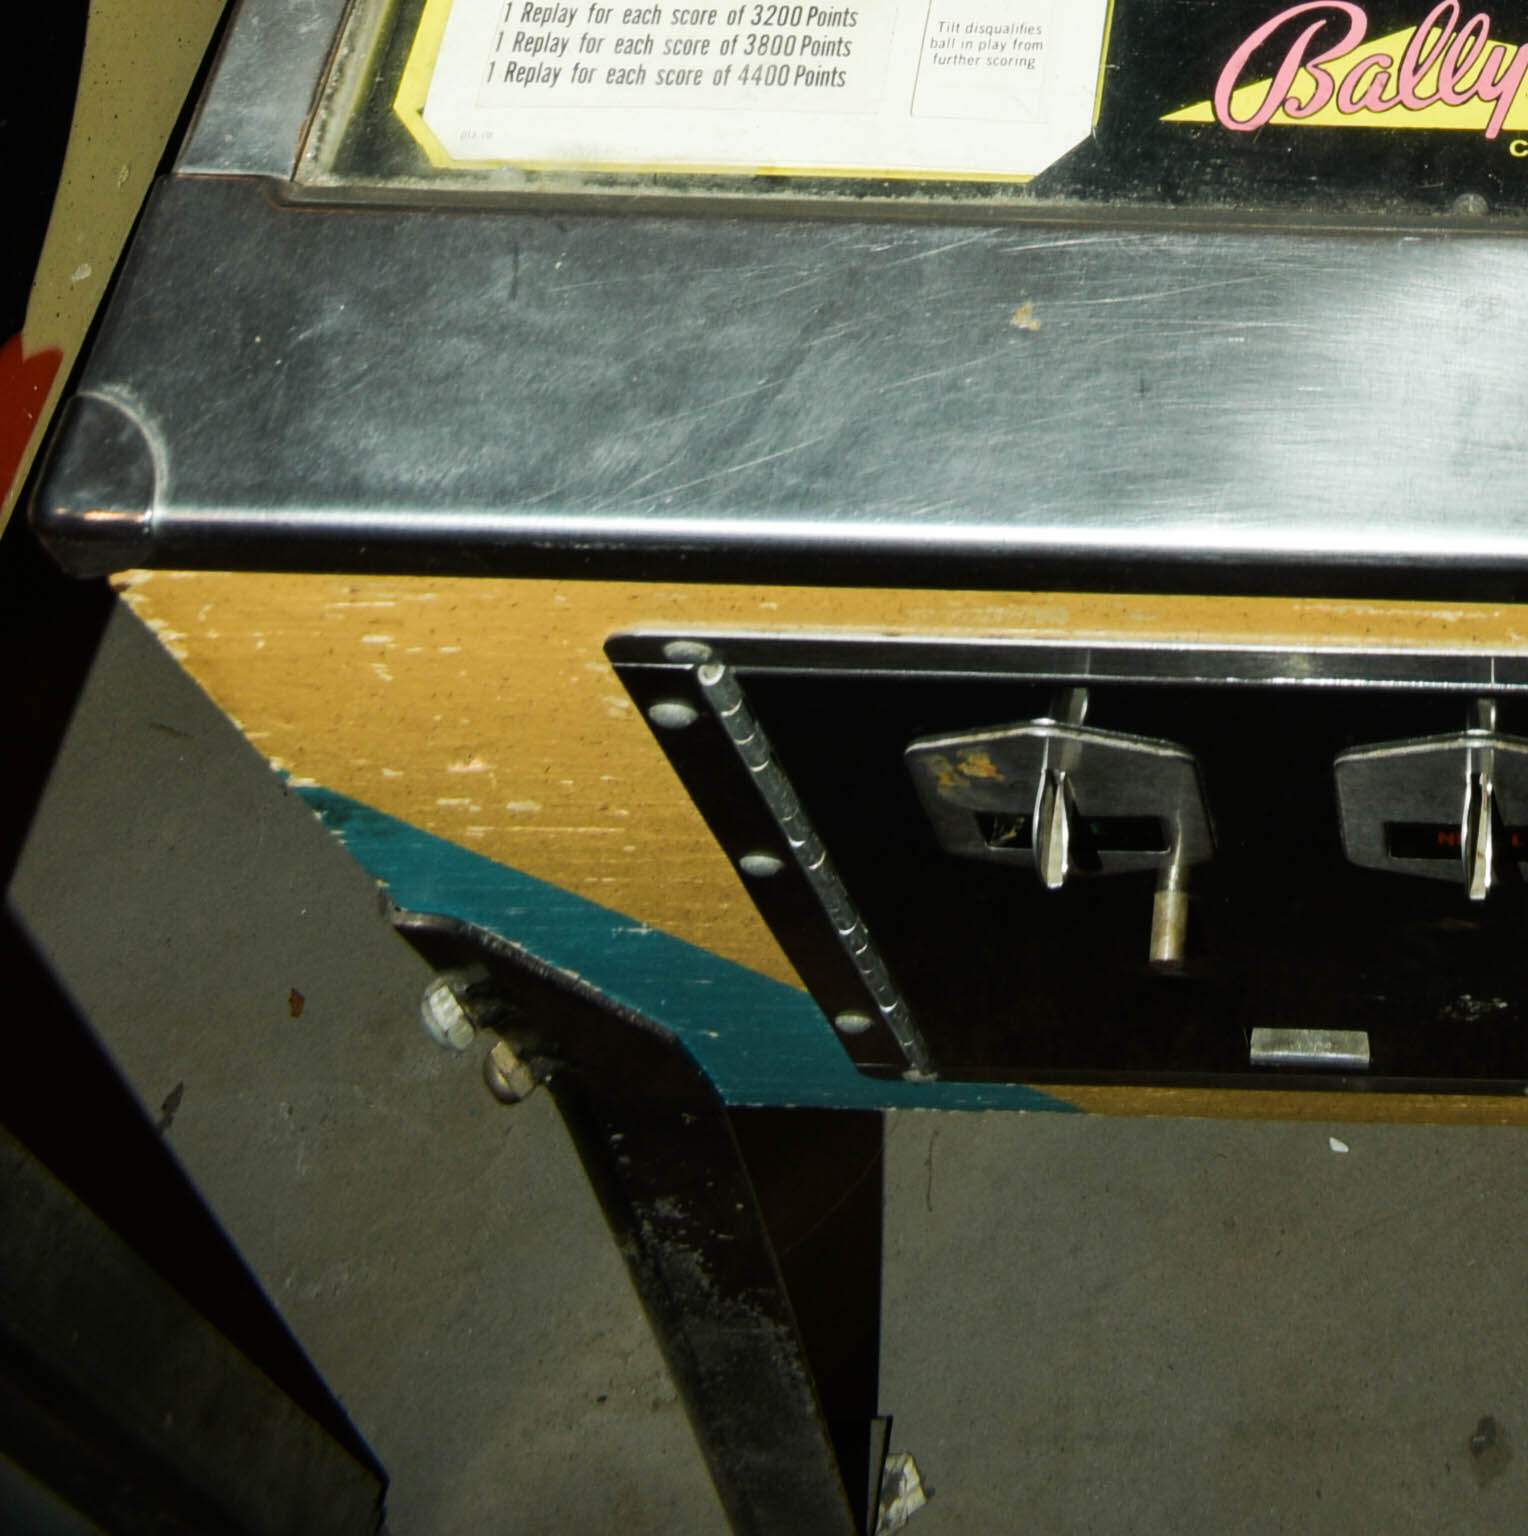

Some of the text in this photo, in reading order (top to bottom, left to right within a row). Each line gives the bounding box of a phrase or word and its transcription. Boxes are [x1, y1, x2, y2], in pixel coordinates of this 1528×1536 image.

[503, 2, 859, 28] 1 Replay for each score of 3200 Points
[495, 31, 853, 58] 1 Replay for each score of 3800 Points
[487, 61, 847, 88] 1 Replay for each score of 4400 Points
